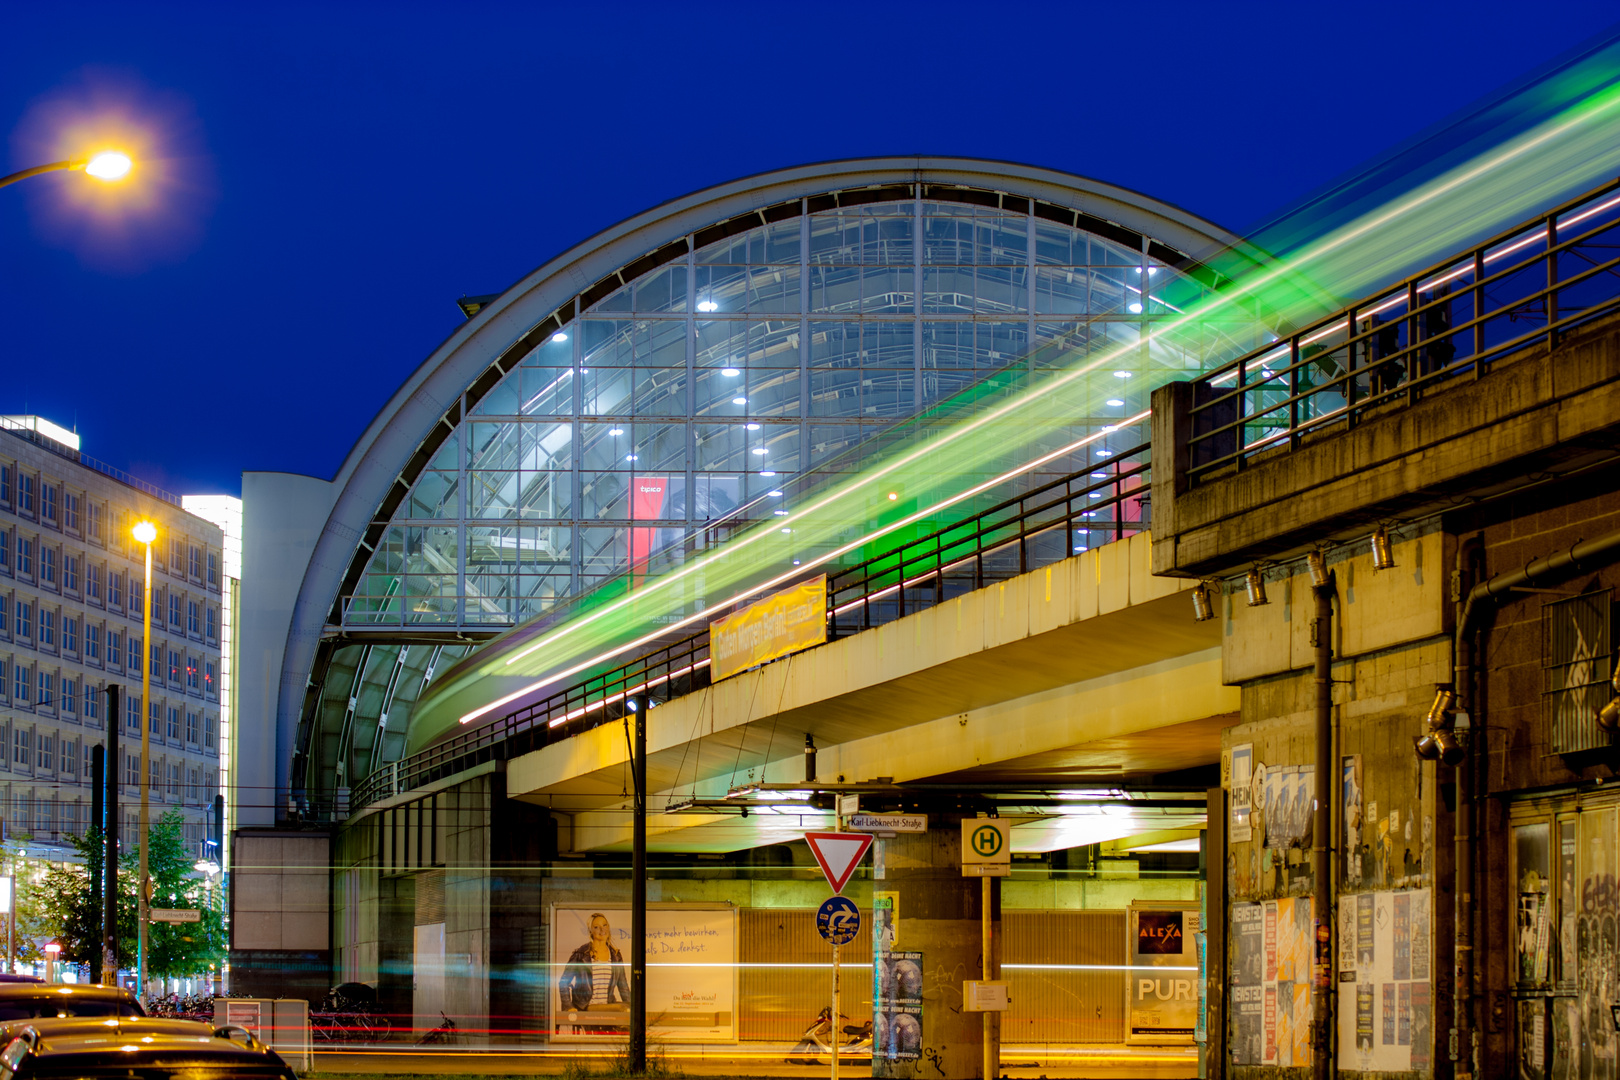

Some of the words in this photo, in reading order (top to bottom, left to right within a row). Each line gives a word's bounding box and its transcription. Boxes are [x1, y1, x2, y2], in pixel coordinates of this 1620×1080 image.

[1232, 786, 1251, 807] HEIN
[851, 818, 922, 829] Karl-Liebknecht-Straße
[664, 926, 682, 938] mehr
[684, 925, 719, 937] bewirken,
[1140, 923, 1182, 944] ALEXA
[660, 941, 674, 953] Du
[904, 1006, 921, 1014] NACHT
